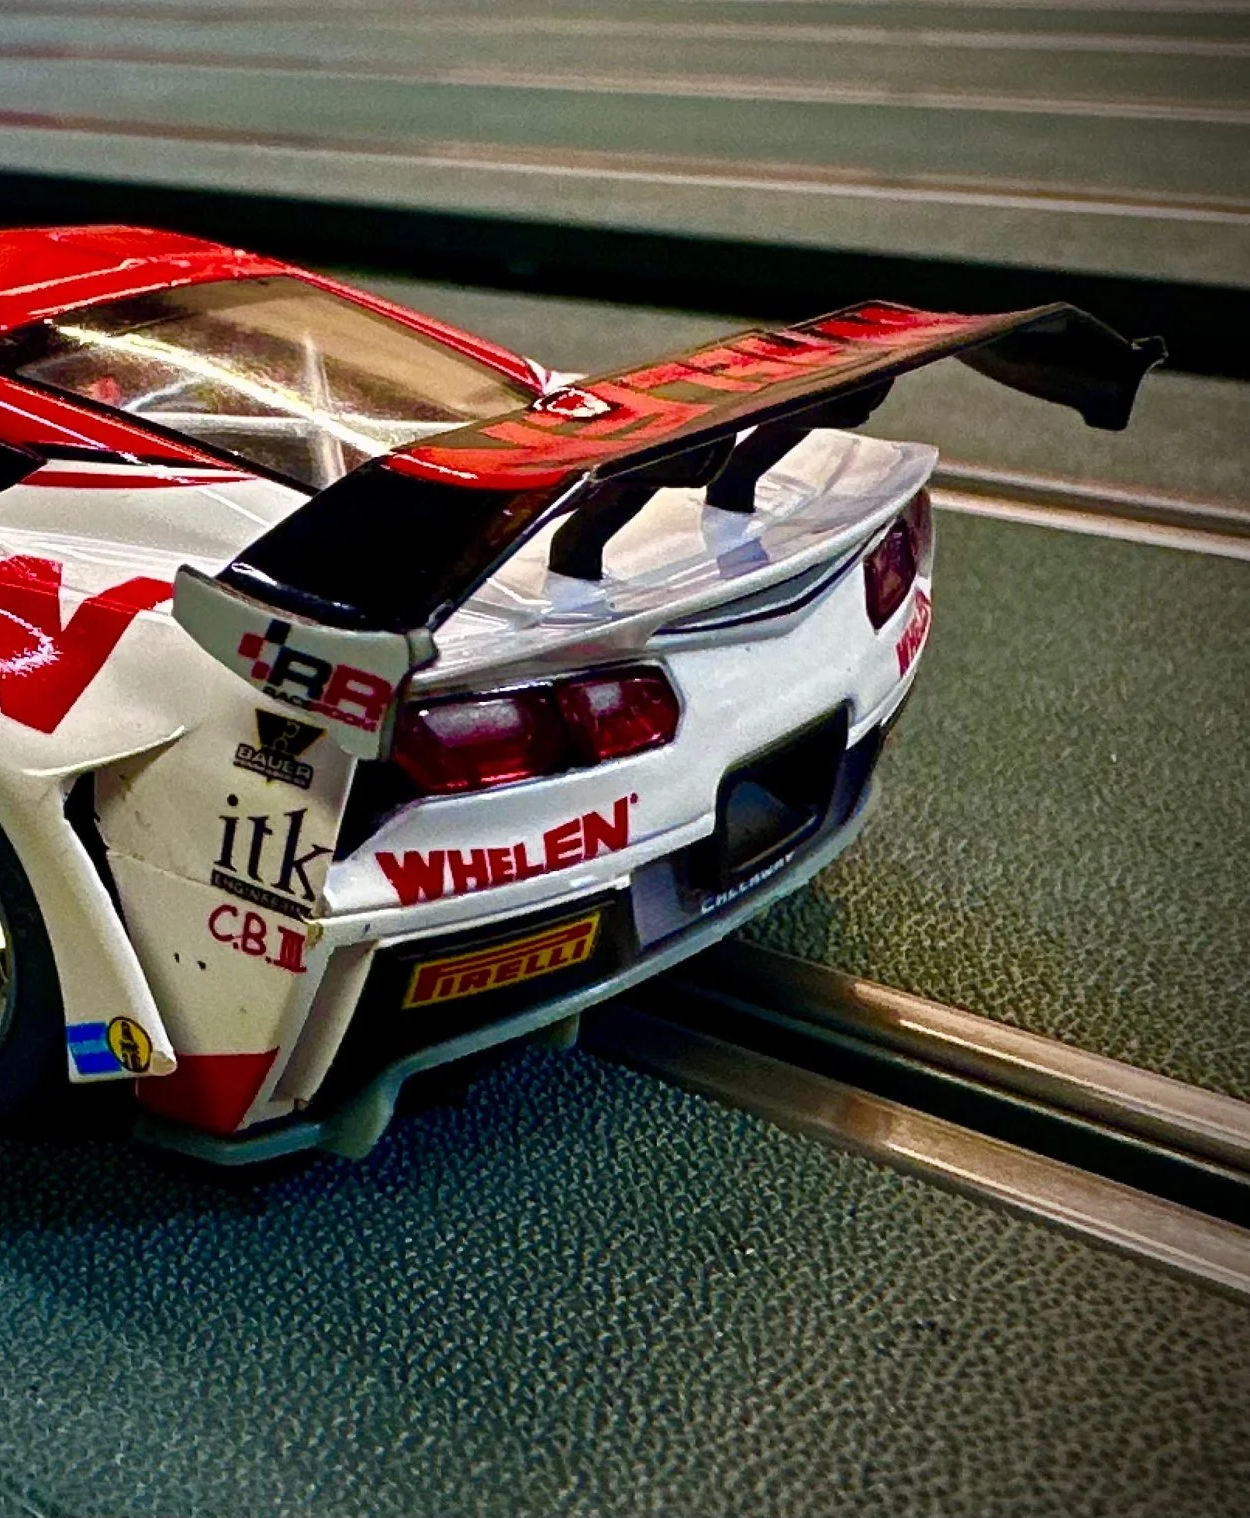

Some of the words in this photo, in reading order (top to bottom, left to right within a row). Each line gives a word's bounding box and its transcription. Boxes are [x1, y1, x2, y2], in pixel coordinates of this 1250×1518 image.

[236, 744, 313, 781] BAUER
[213, 793, 334, 902] itk
[411, 921, 595, 1003] PIRELLI
